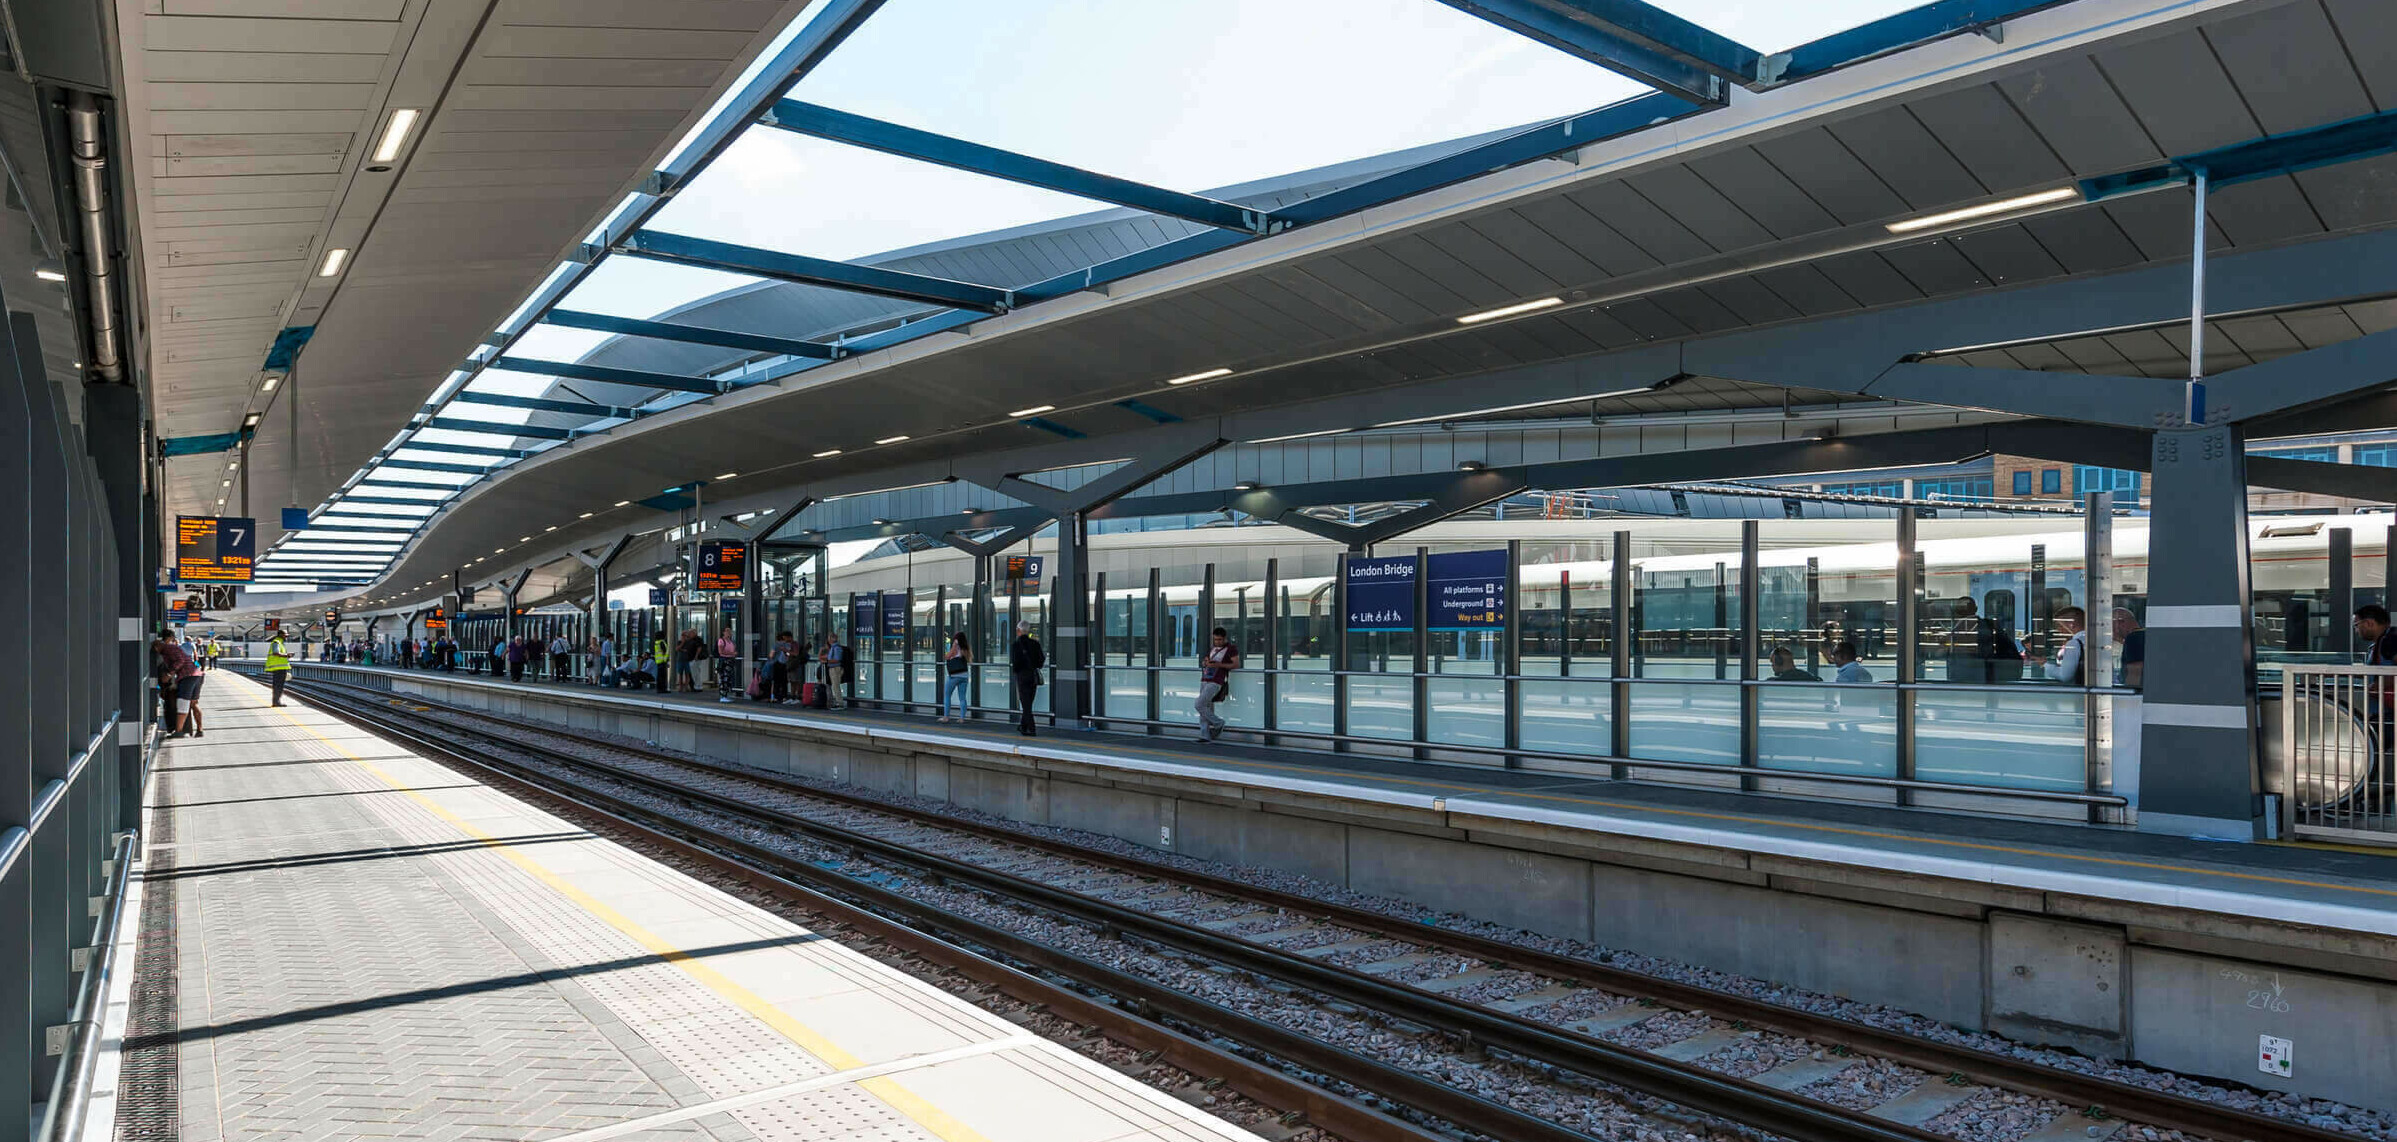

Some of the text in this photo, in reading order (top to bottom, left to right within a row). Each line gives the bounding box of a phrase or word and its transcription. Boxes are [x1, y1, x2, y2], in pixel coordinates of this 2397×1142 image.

[230, 529, 245, 546] 7
[704, 553, 715, 566] 8
[1029, 563, 1038, 575] 9
[1350, 563, 1414, 577] London Bridge
[1443, 585, 1484, 595] All platforms
[1443, 600, 1483, 608] Underground
[1360, 612, 1374, 622] Lift
[1458, 613, 1483, 622] Way out
